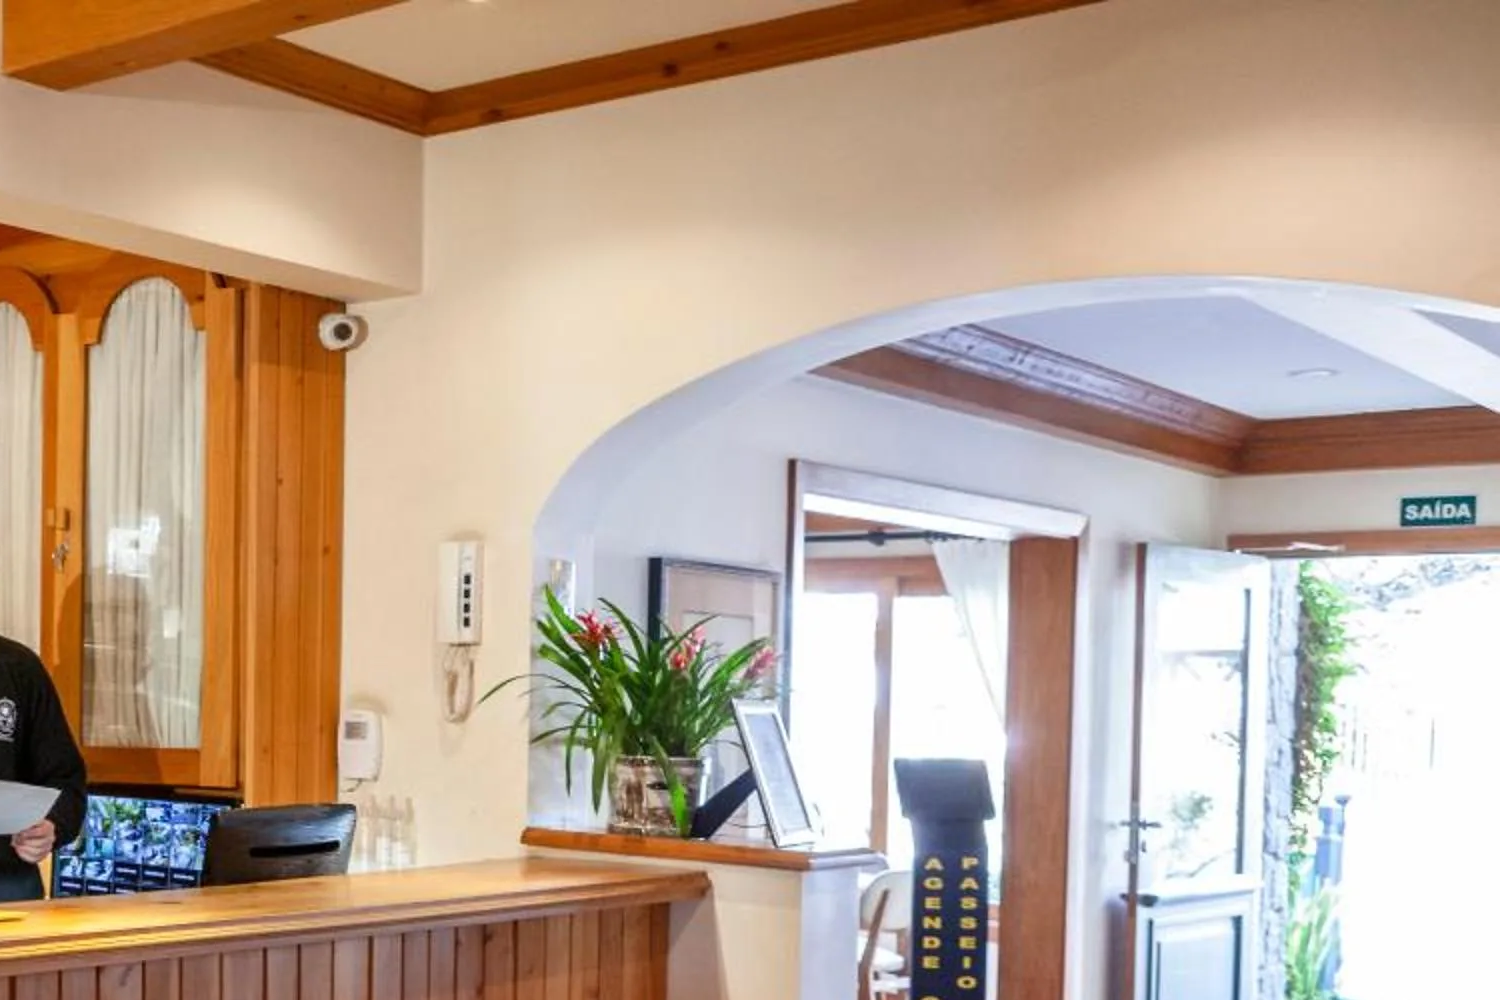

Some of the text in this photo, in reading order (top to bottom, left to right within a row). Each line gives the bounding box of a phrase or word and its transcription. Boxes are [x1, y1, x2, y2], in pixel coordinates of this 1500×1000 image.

[1404, 500, 1472, 520] SAÍDA
[921, 857, 944, 969] AGENDE
[956, 856, 980, 989] PASSEIO
